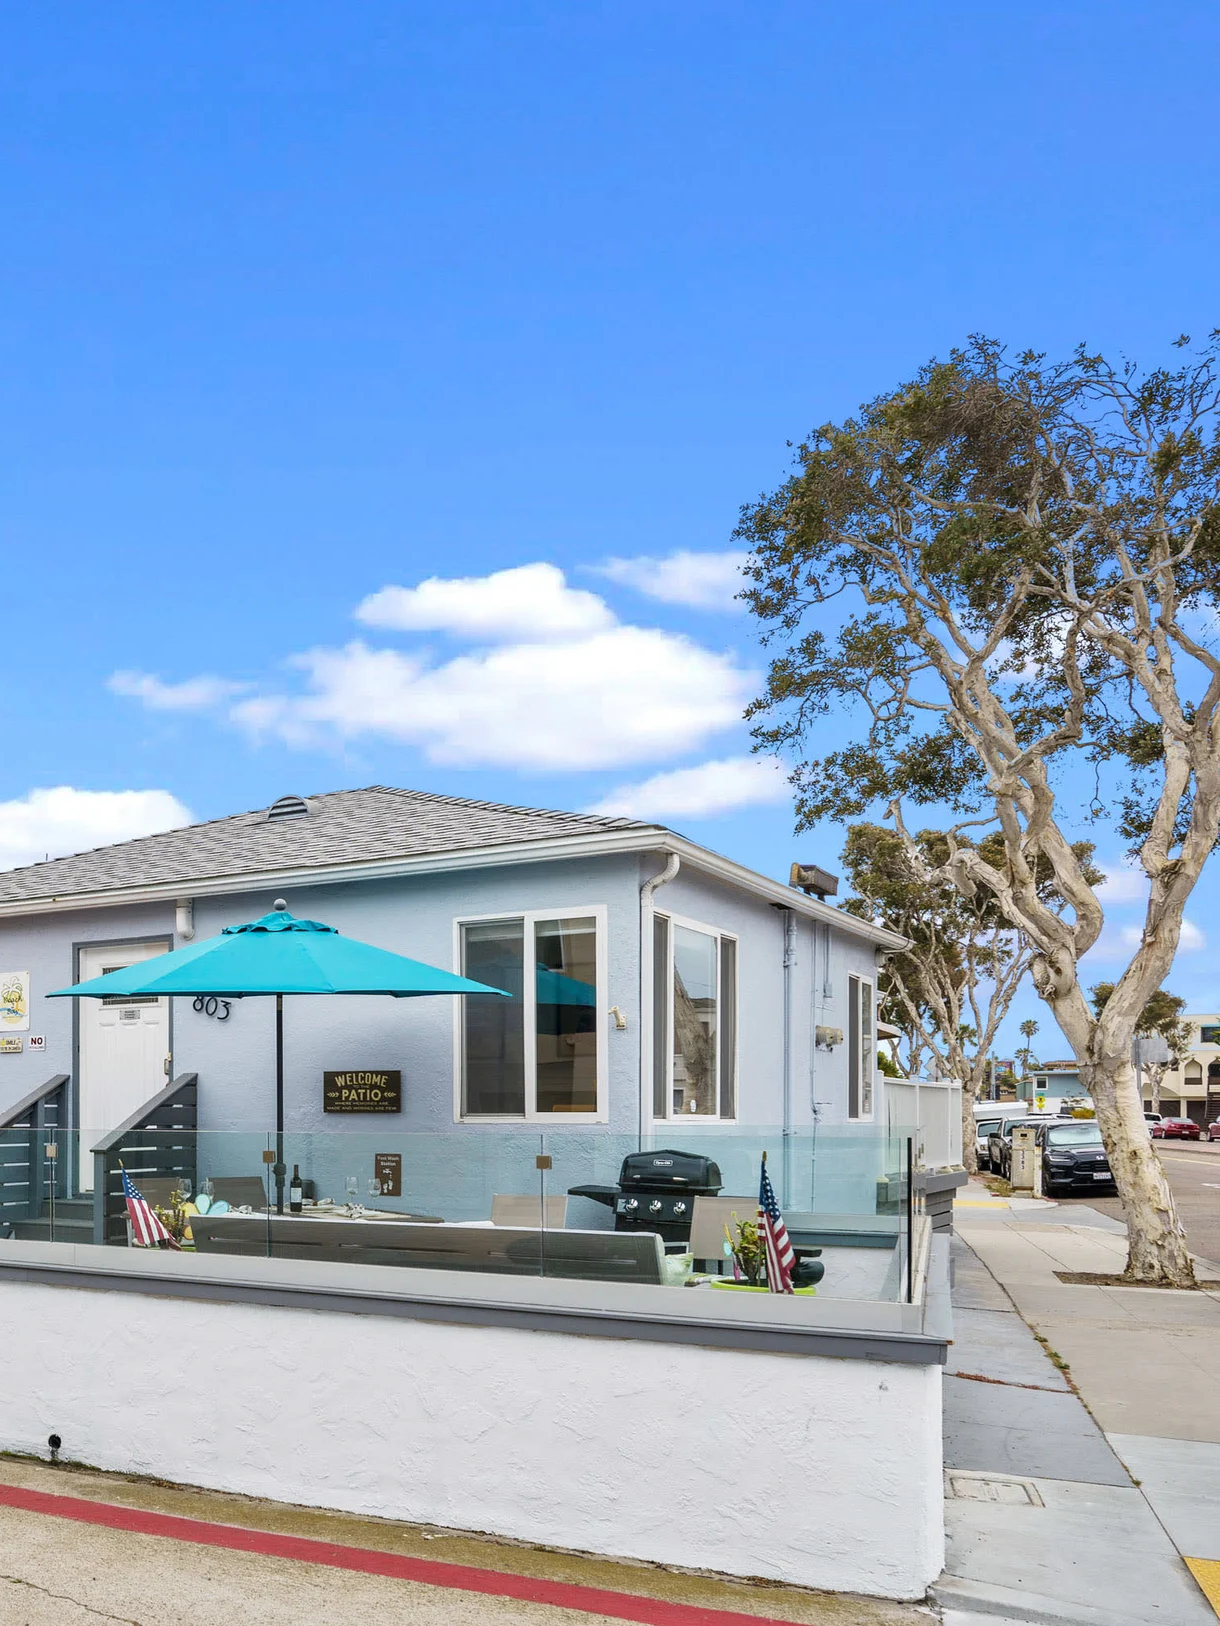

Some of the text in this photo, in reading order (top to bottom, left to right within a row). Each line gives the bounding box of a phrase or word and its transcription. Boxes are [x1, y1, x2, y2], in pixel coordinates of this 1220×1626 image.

[192, 996, 231, 1019] 803
[31, 1038, 43, 1046] NO
[335, 1072, 388, 1087] WELCOME
[342, 1089, 381, 1101] PATIO
